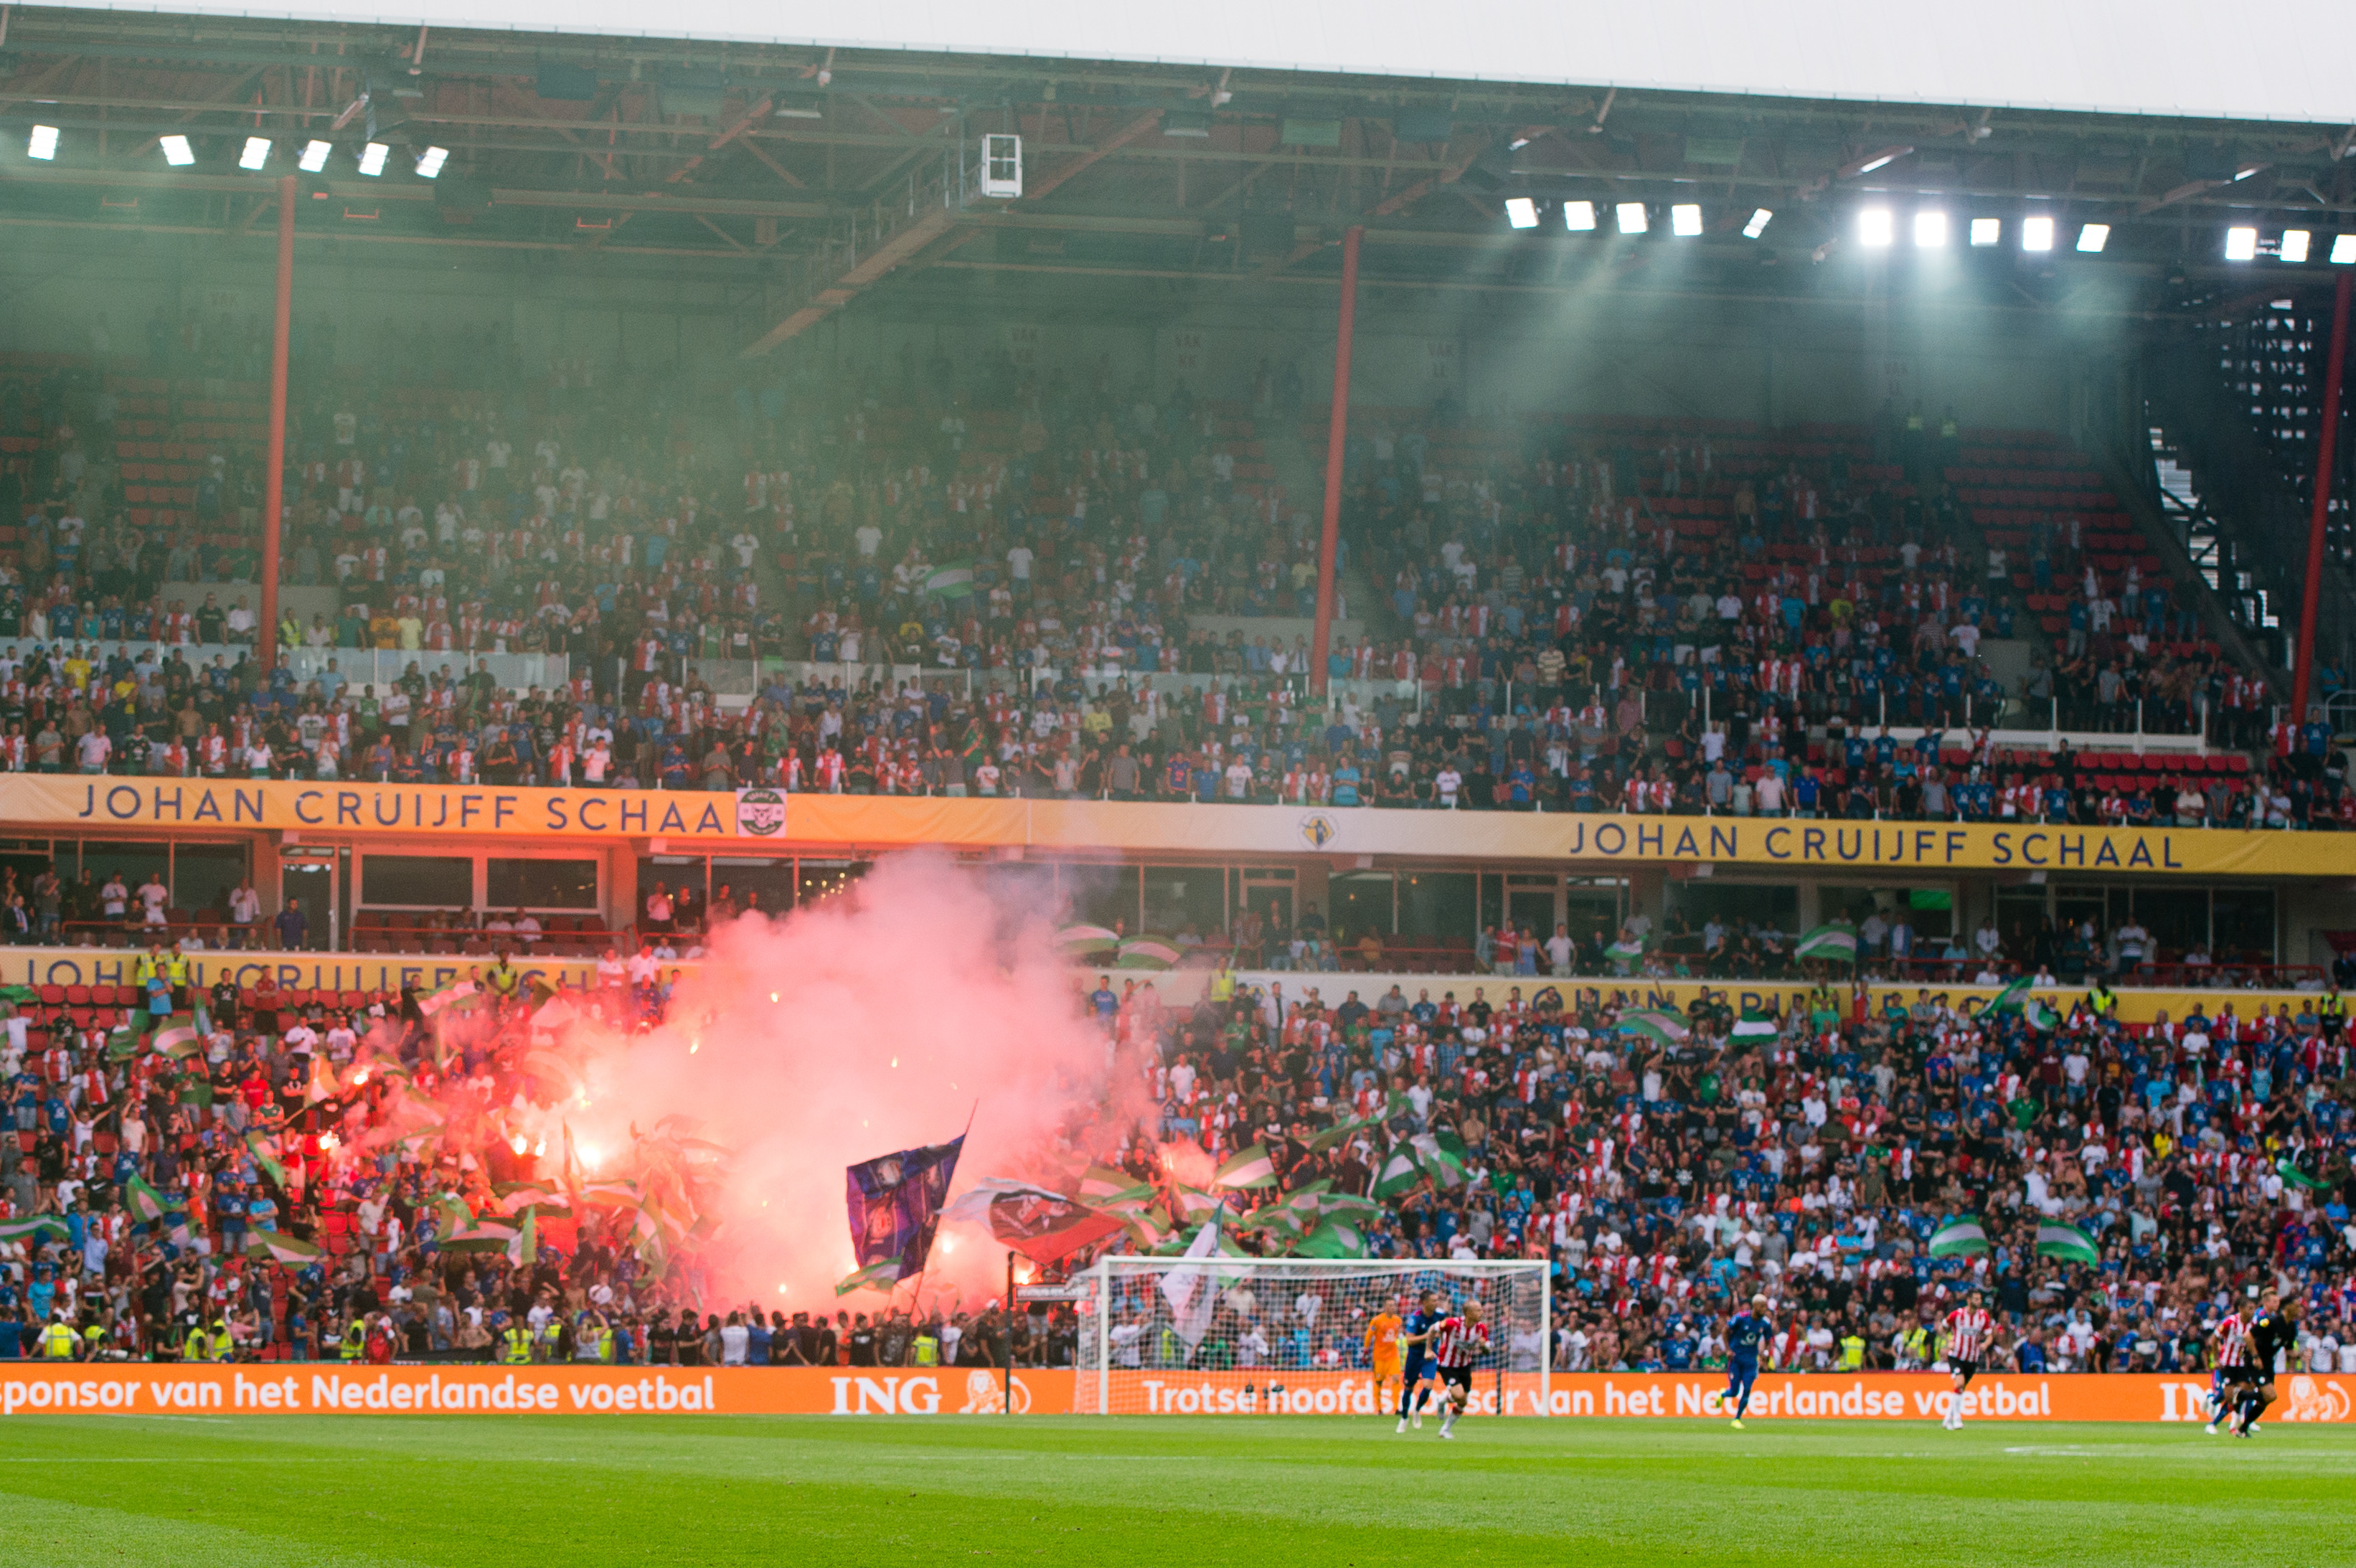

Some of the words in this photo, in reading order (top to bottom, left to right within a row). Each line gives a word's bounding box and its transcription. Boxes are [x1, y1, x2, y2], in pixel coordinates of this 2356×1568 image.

[78, 784, 263, 823] JOHAN
[295, 790, 517, 828] CRUIJFF
[547, 797, 739, 835] SCHAA
[1570, 822, 1737, 858] JOHAN
[1765, 826, 1966, 863] CRUIJFF
[1992, 832, 2182, 869] SCHAAL
[28, 958, 204, 988] JOH
[0, 1381, 141, 1414] ponsor
[149, 1382, 222, 1408] van
[234, 1371, 300, 1408] het
[311, 1374, 559, 1409] Nederlandse
[569, 1375, 715, 1410] voetbal
[829, 1376, 943, 1414] ING
[1142, 1379, 1258, 1414] Trotse
[1268, 1379, 1519, 1414] hoofdsosor
[1527, 1389, 1595, 1414] van
[1605, 1381, 1665, 1414] het
[1913, 1382, 2052, 1416] voetbal
